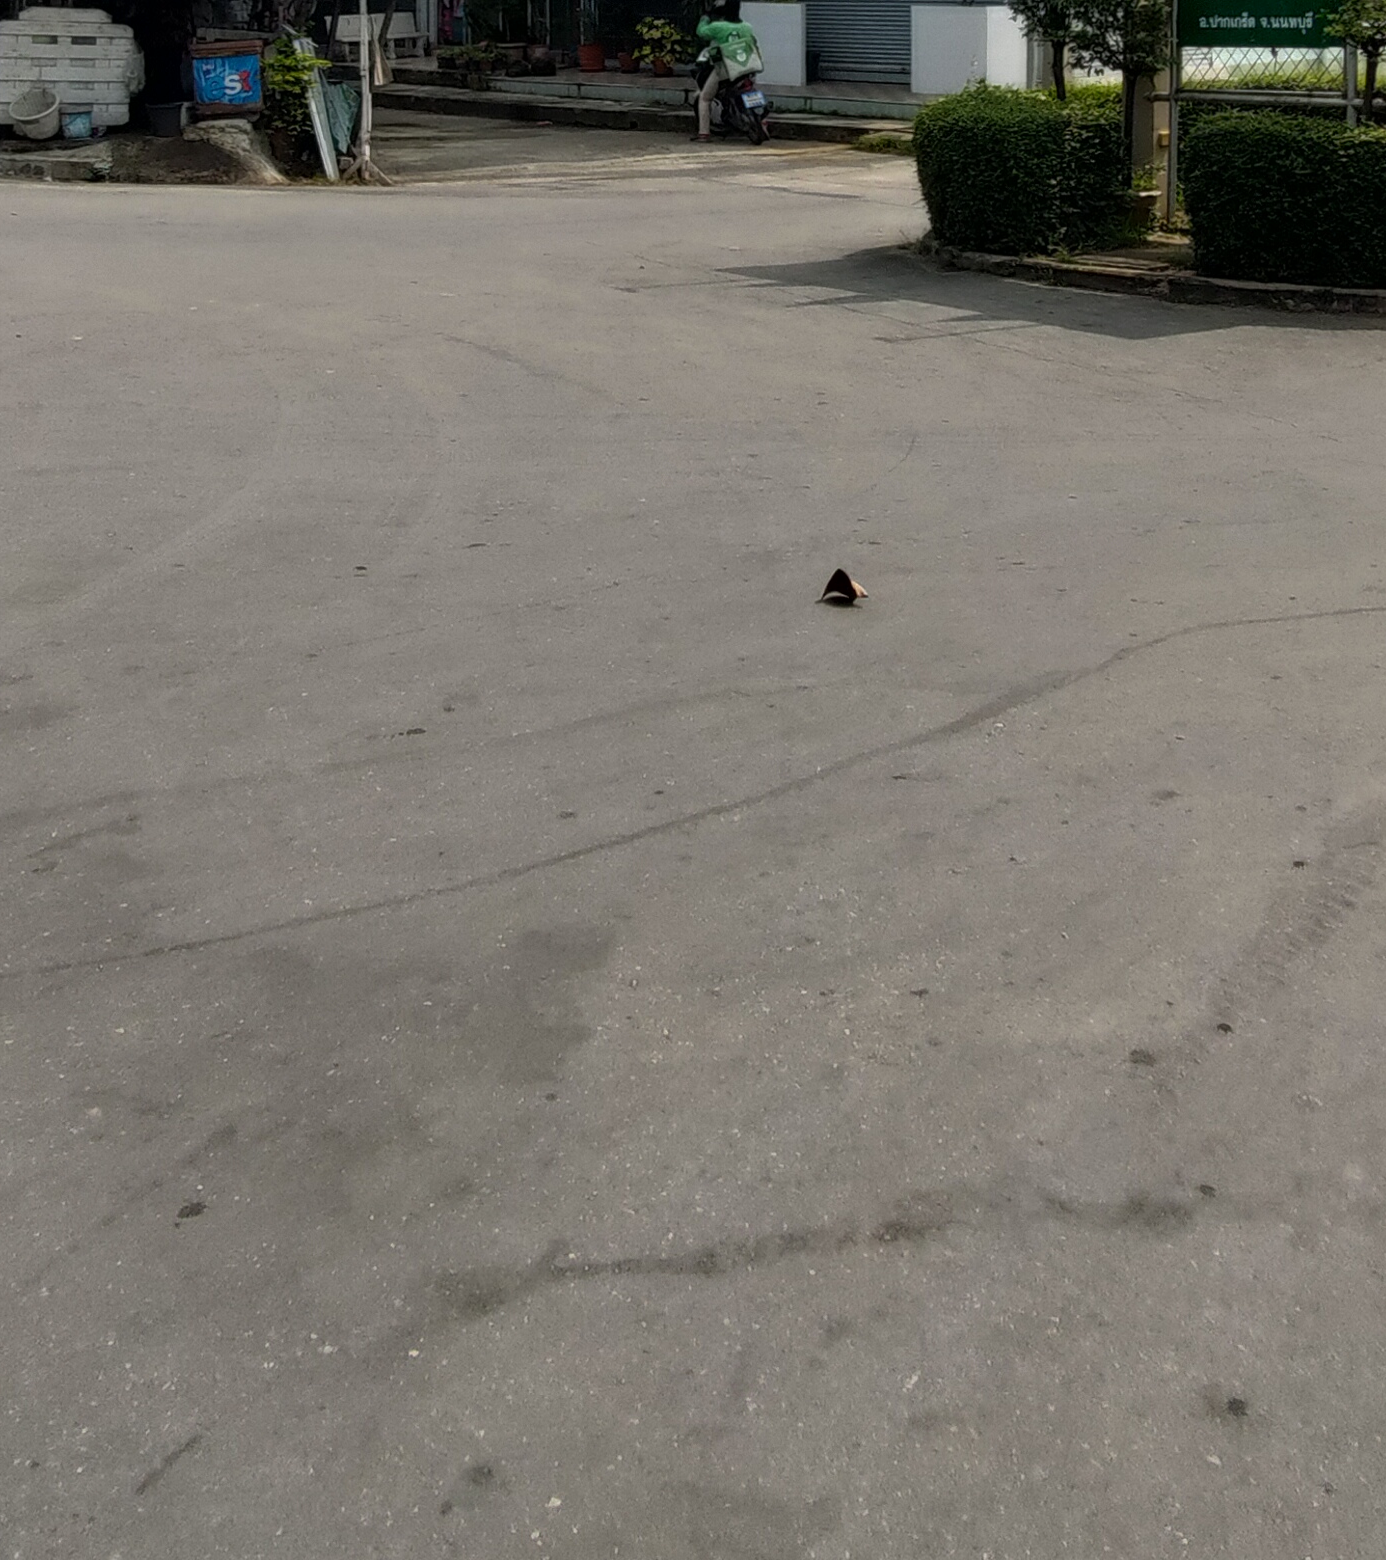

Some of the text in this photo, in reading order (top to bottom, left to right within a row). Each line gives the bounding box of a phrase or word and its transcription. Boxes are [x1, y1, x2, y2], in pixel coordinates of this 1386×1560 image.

[1199, 11, 1314, 35] อ.ปากเกร็ด จ.นนทบุรี
